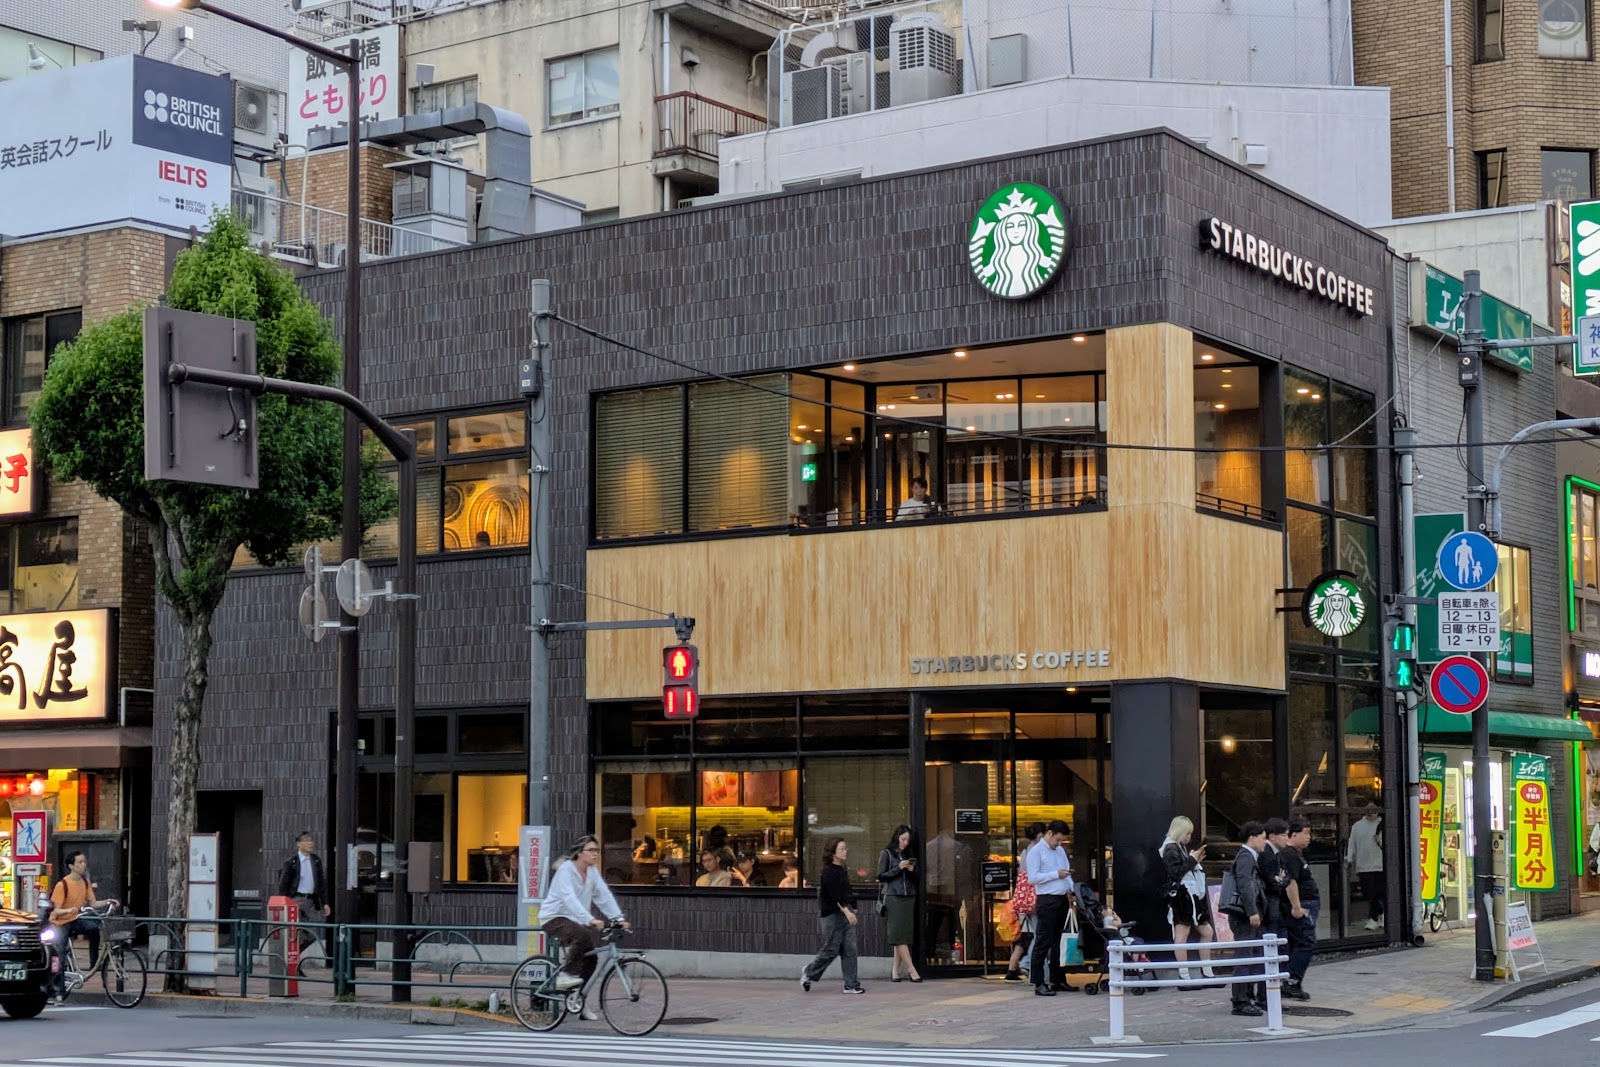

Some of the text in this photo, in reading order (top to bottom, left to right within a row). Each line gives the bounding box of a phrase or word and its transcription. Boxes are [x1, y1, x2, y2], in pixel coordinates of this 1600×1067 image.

[171, 97, 220, 121] BRITISH
[170, 111, 223, 136] COUNCIL
[1, 128, 113, 170] 英会話スクール
[158, 160, 208, 189] IELTS
[185, 199, 206, 209] BRITISH
[185, 205, 207, 215] COUNCIL
[1210, 217, 1374, 316] STARBUCKS COFFEE
[0, 453, 28, 494] 子
[1442, 597, 1496, 608] 自転車を除く
[910, 650, 1110, 675] STARBUCKS COFFEE
[1518, 760, 1546, 776] エイブル
[1524, 807, 1547, 883] 半月分
[529, 837, 540, 897] 交通事故多発
